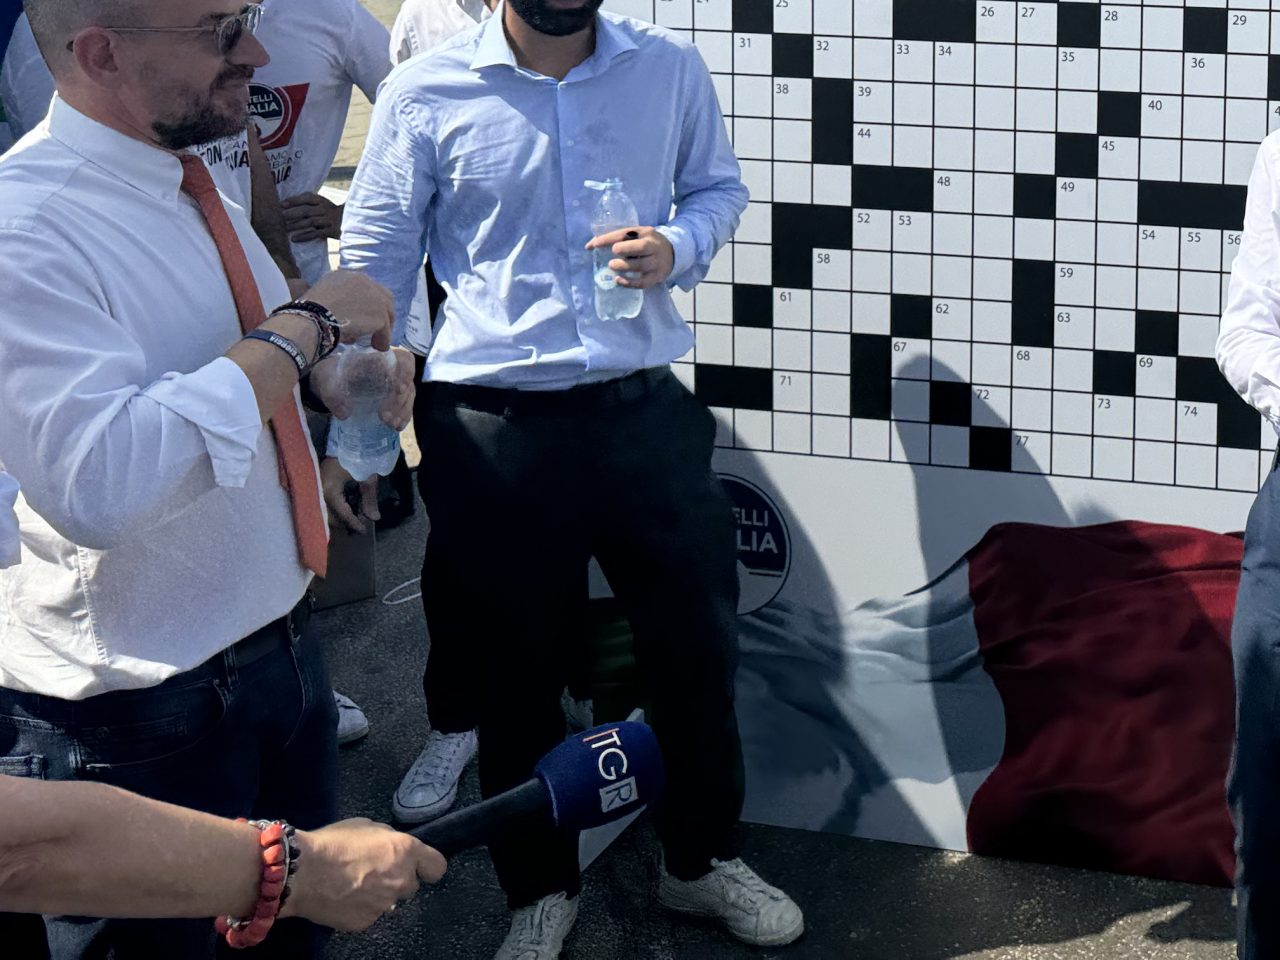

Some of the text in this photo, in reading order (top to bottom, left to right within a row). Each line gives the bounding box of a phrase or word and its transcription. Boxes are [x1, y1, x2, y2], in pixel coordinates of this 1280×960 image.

[981, 6, 994, 17] 26
[1233, 15, 1246, 25] 29
[817, 41, 829, 51] 32
[1192, 58, 1205, 68] 36
[858, 86, 871, 96] 39
[858, 128, 871, 138] 44
[1061, 182, 1074, 192] 49
[899, 215, 911, 225] 53
[1187, 232, 1200, 242] 55
[1060, 268, 1073, 278] 59
[894, 342, 906, 351] 67
[1098, 398, 1110, 409] 73
